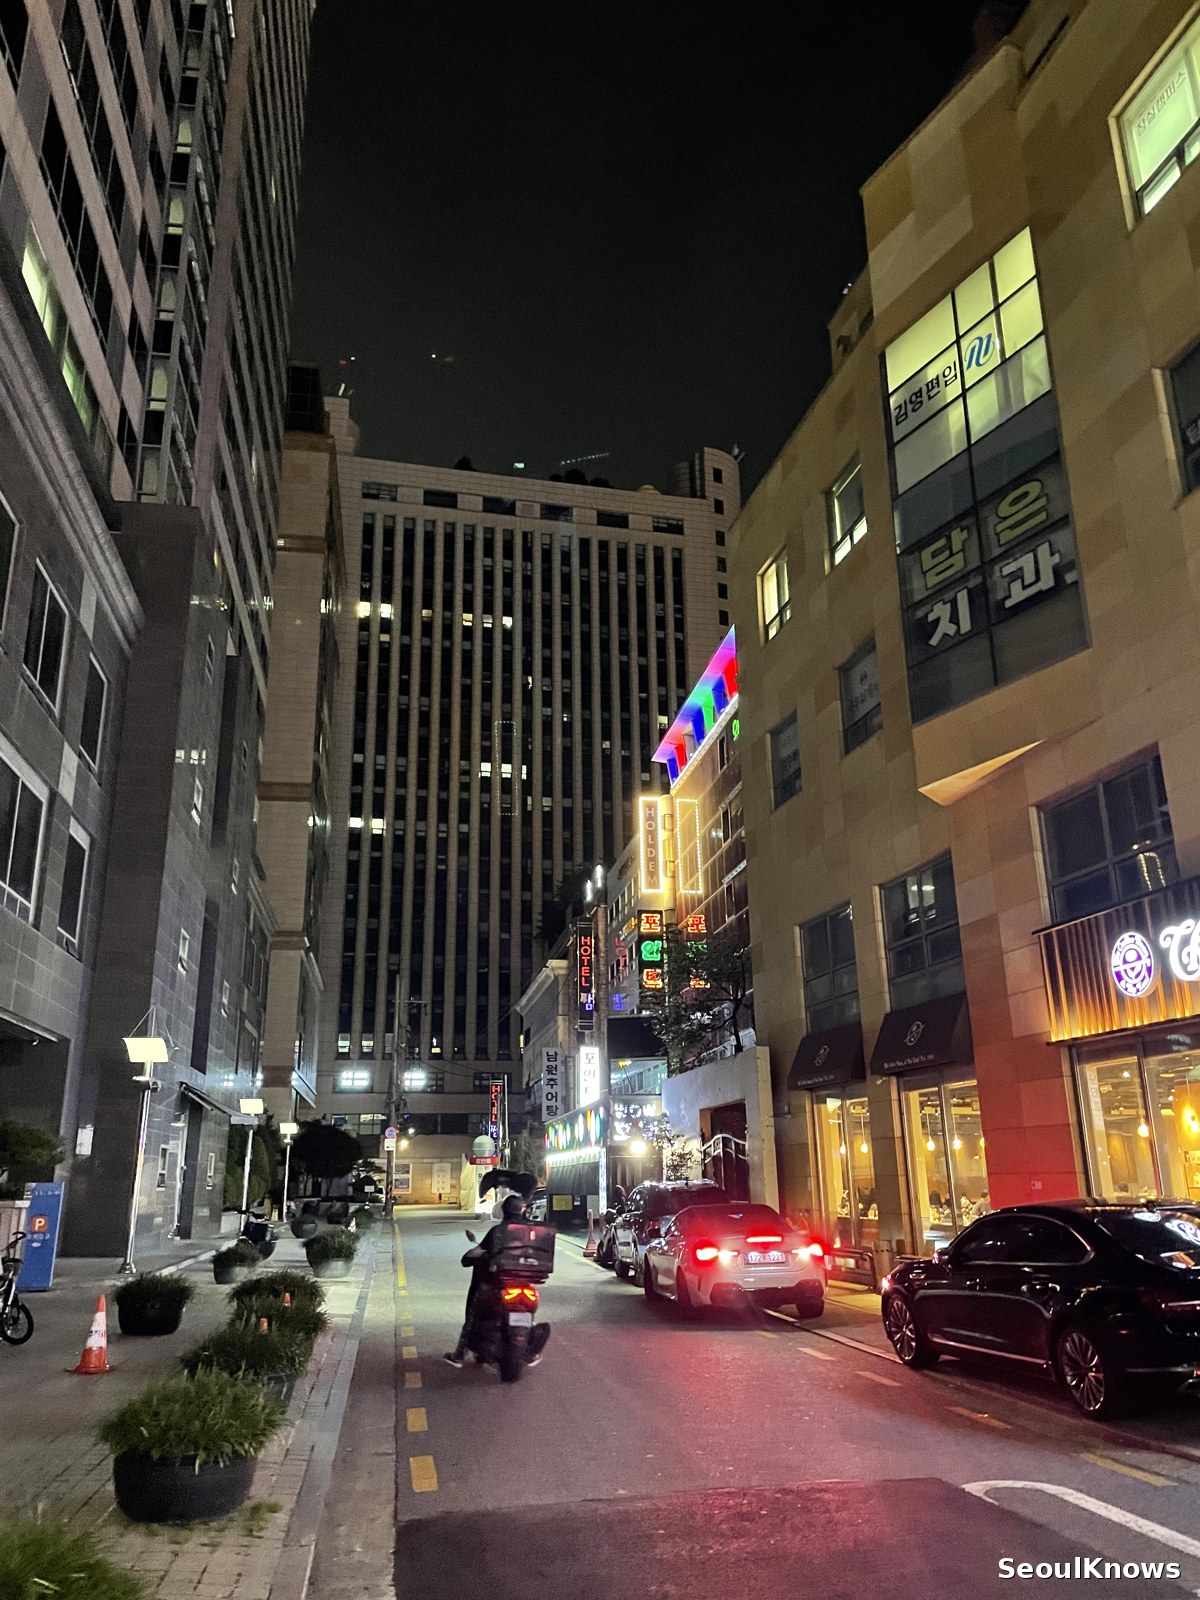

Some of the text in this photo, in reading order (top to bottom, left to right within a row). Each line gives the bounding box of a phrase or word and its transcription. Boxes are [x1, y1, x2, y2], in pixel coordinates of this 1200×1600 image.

[894, 361, 958, 426] 김영편입
[920, 480, 1049, 590] 담은
[927, 541, 1061, 647] 치과
[645, 807, 658, 886] HOLDEM
[580, 936, 591, 987] HOTEL
[545, 1050, 560, 1117] 남원추어탕
[35, 1218, 45, 1231] P
